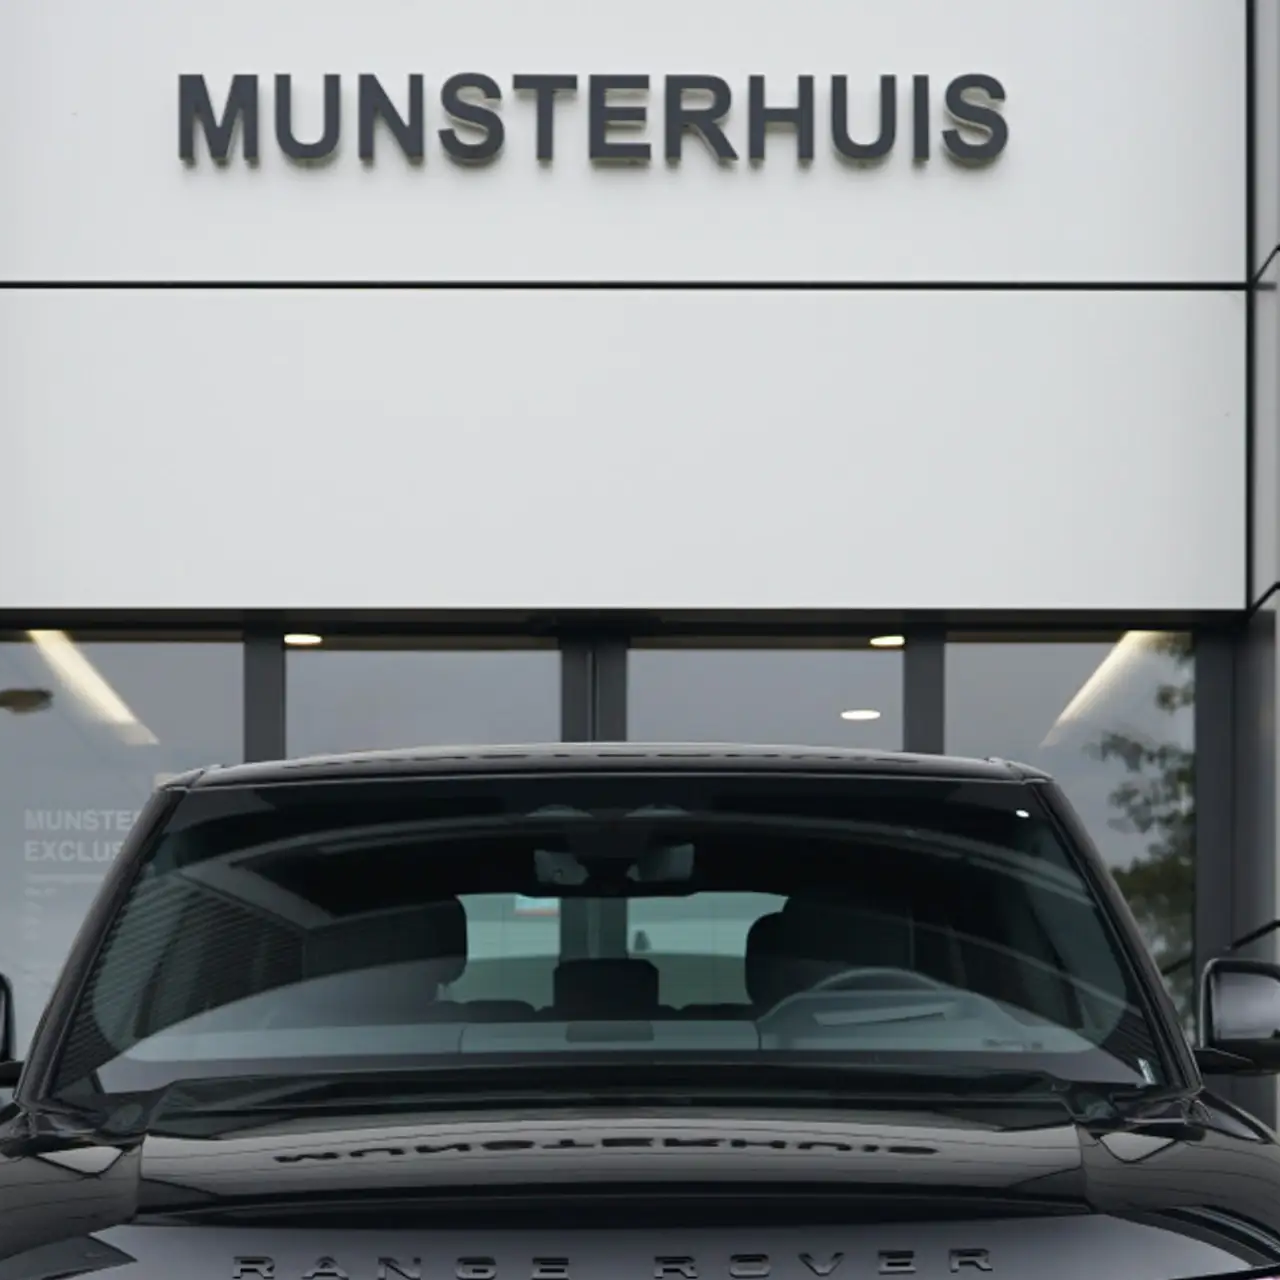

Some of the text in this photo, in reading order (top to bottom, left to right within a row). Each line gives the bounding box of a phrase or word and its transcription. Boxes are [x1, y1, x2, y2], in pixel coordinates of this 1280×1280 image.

[177, 72, 1009, 163] MUNSTERHUIS
[232, 1249, 993, 1280] RANGE ROVER
